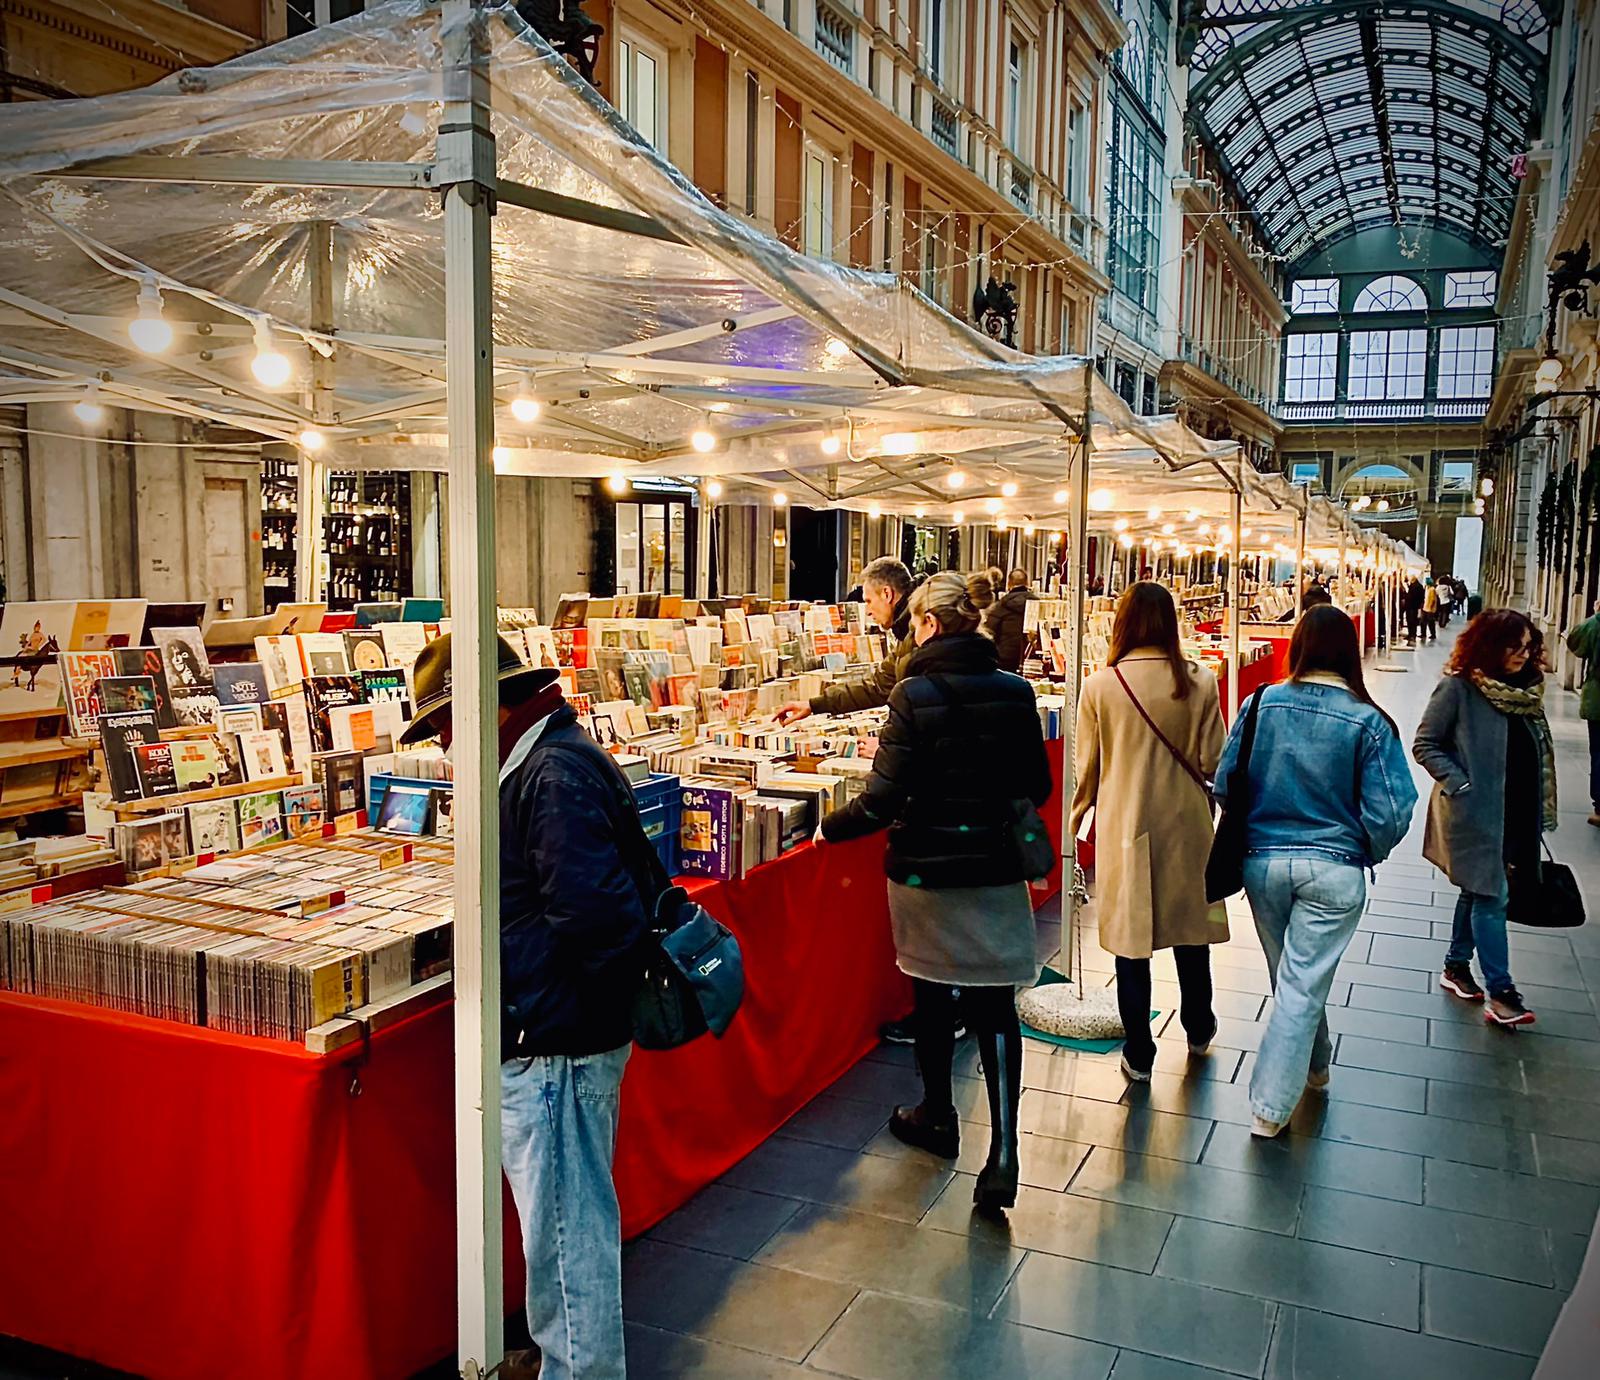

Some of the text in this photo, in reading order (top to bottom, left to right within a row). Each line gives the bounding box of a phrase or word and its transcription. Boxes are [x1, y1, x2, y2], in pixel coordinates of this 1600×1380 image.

[365, 677, 398, 686] OXFORD
[319, 692, 354, 703] MUSICA
[367, 686, 410, 704] JAZZ
